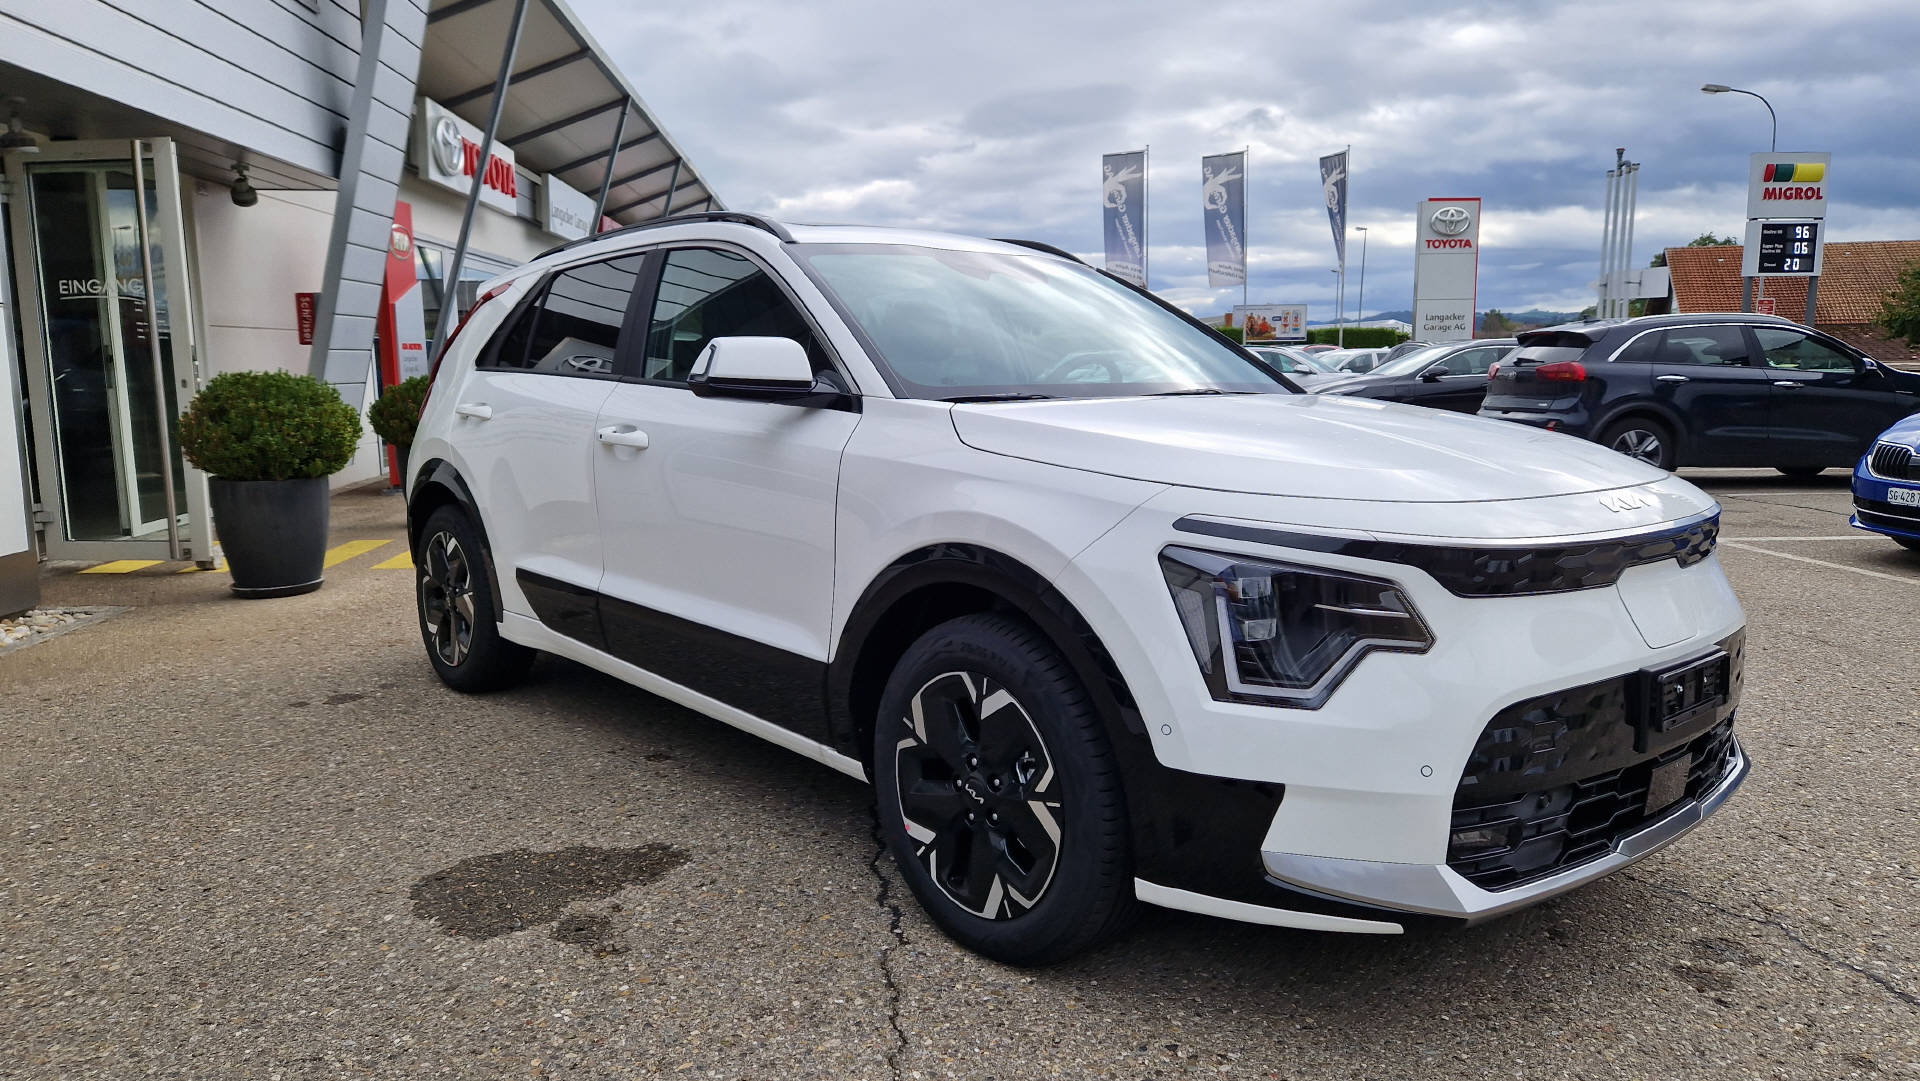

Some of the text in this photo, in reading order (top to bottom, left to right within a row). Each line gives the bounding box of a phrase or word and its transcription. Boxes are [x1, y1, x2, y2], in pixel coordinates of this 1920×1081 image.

[461, 136, 517, 198] TOOTA
[1763, 187, 1823, 200] MIGROL
[1795, 226, 1810, 239] 96
[1426, 239, 1472, 249] TOYOTA
[1793, 241, 1808, 254] 06
[59, 279, 145, 294] EINGANG
[1425, 313, 1465, 322] Langacker
[1423, 323, 1467, 332] Garage AG
[1889, 490, 1898, 500] SG
